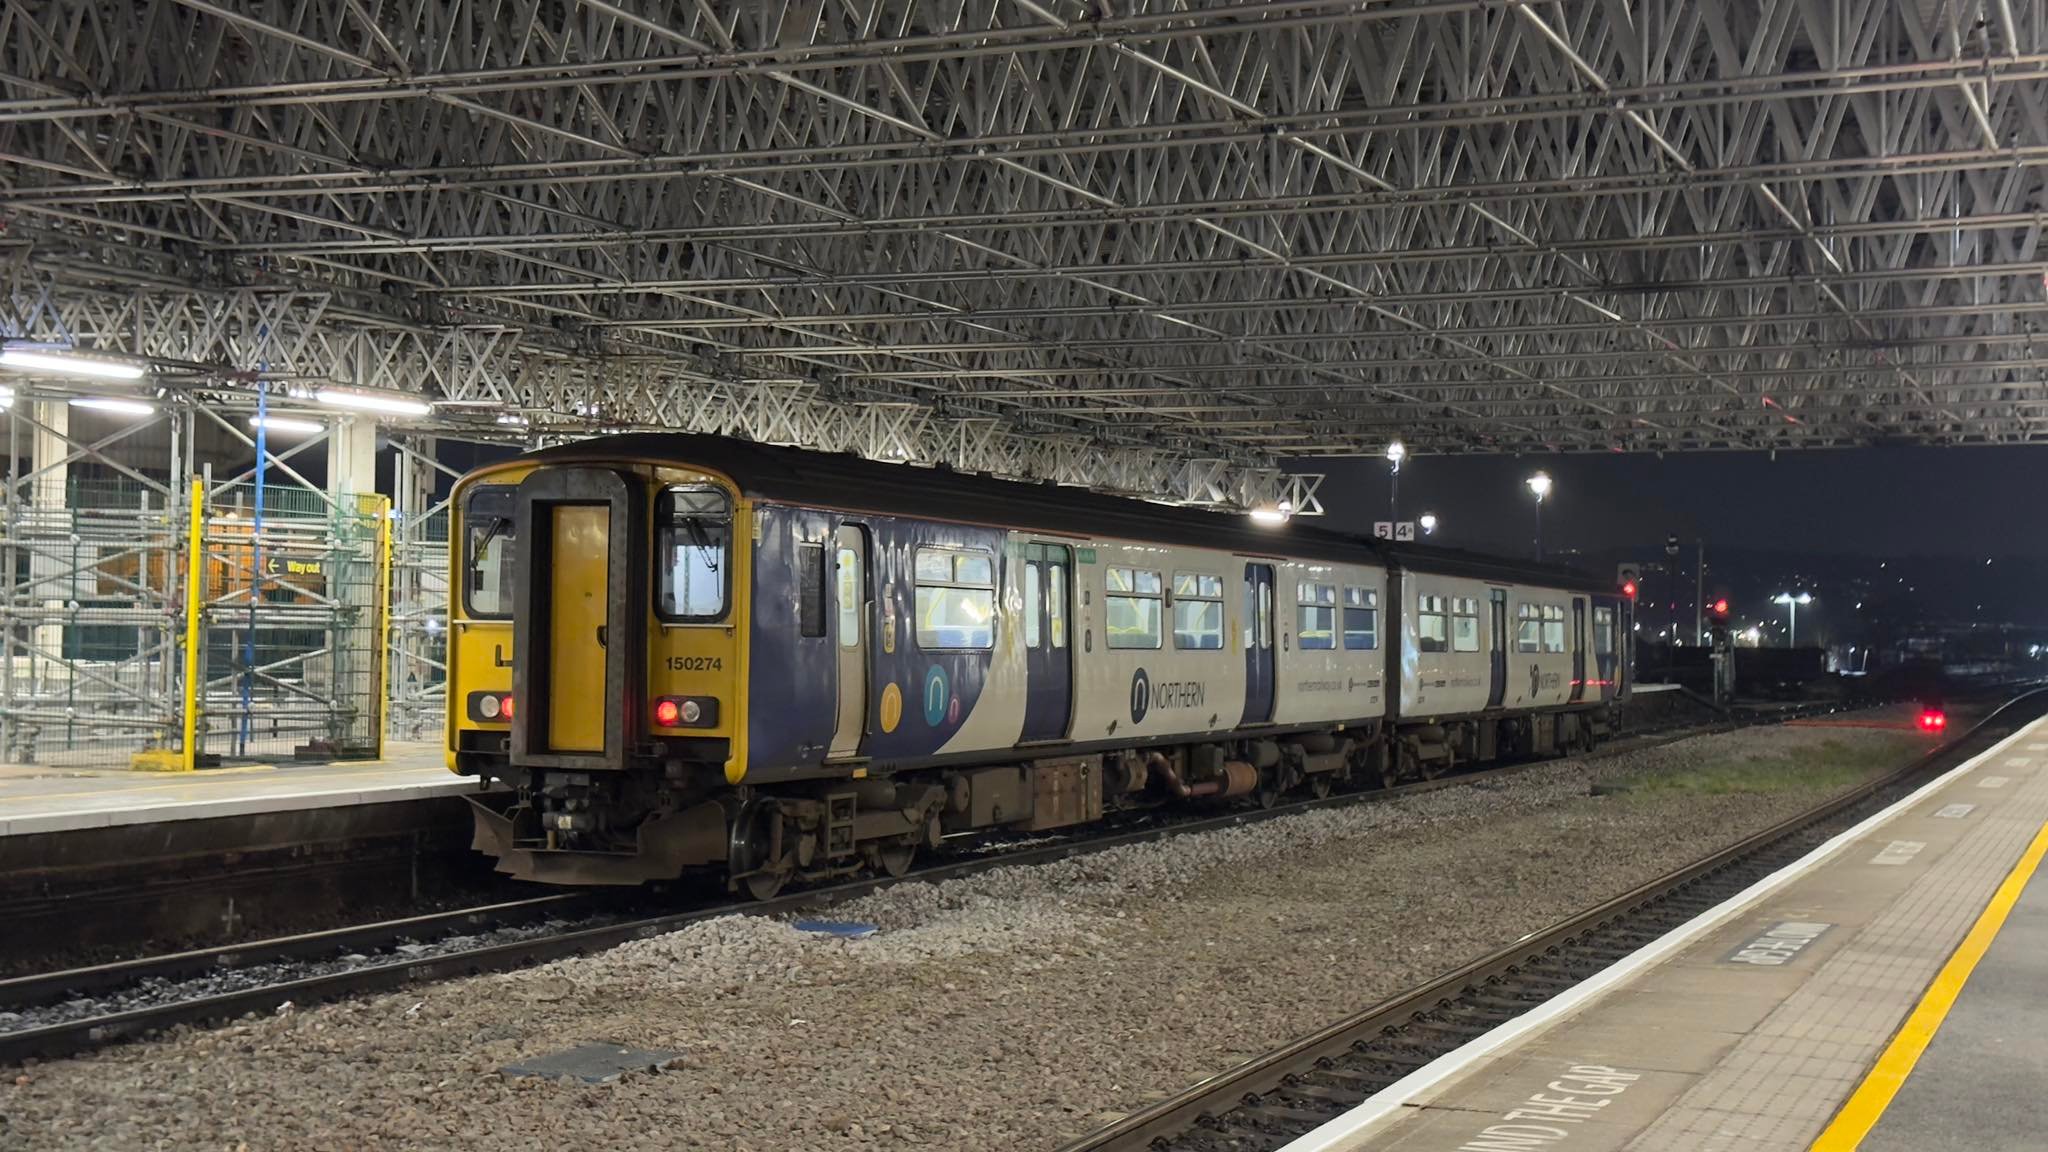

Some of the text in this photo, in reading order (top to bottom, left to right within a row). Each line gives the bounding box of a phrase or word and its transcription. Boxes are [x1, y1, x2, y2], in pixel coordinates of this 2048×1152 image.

[1379, 525, 1388, 538] 5
[287, 560, 320, 574] Way out
[666, 656, 722, 671] 150274
[1151, 682, 1205, 709] NORTHERN
[1454, 1065, 1640, 1152] IND THE GAP
